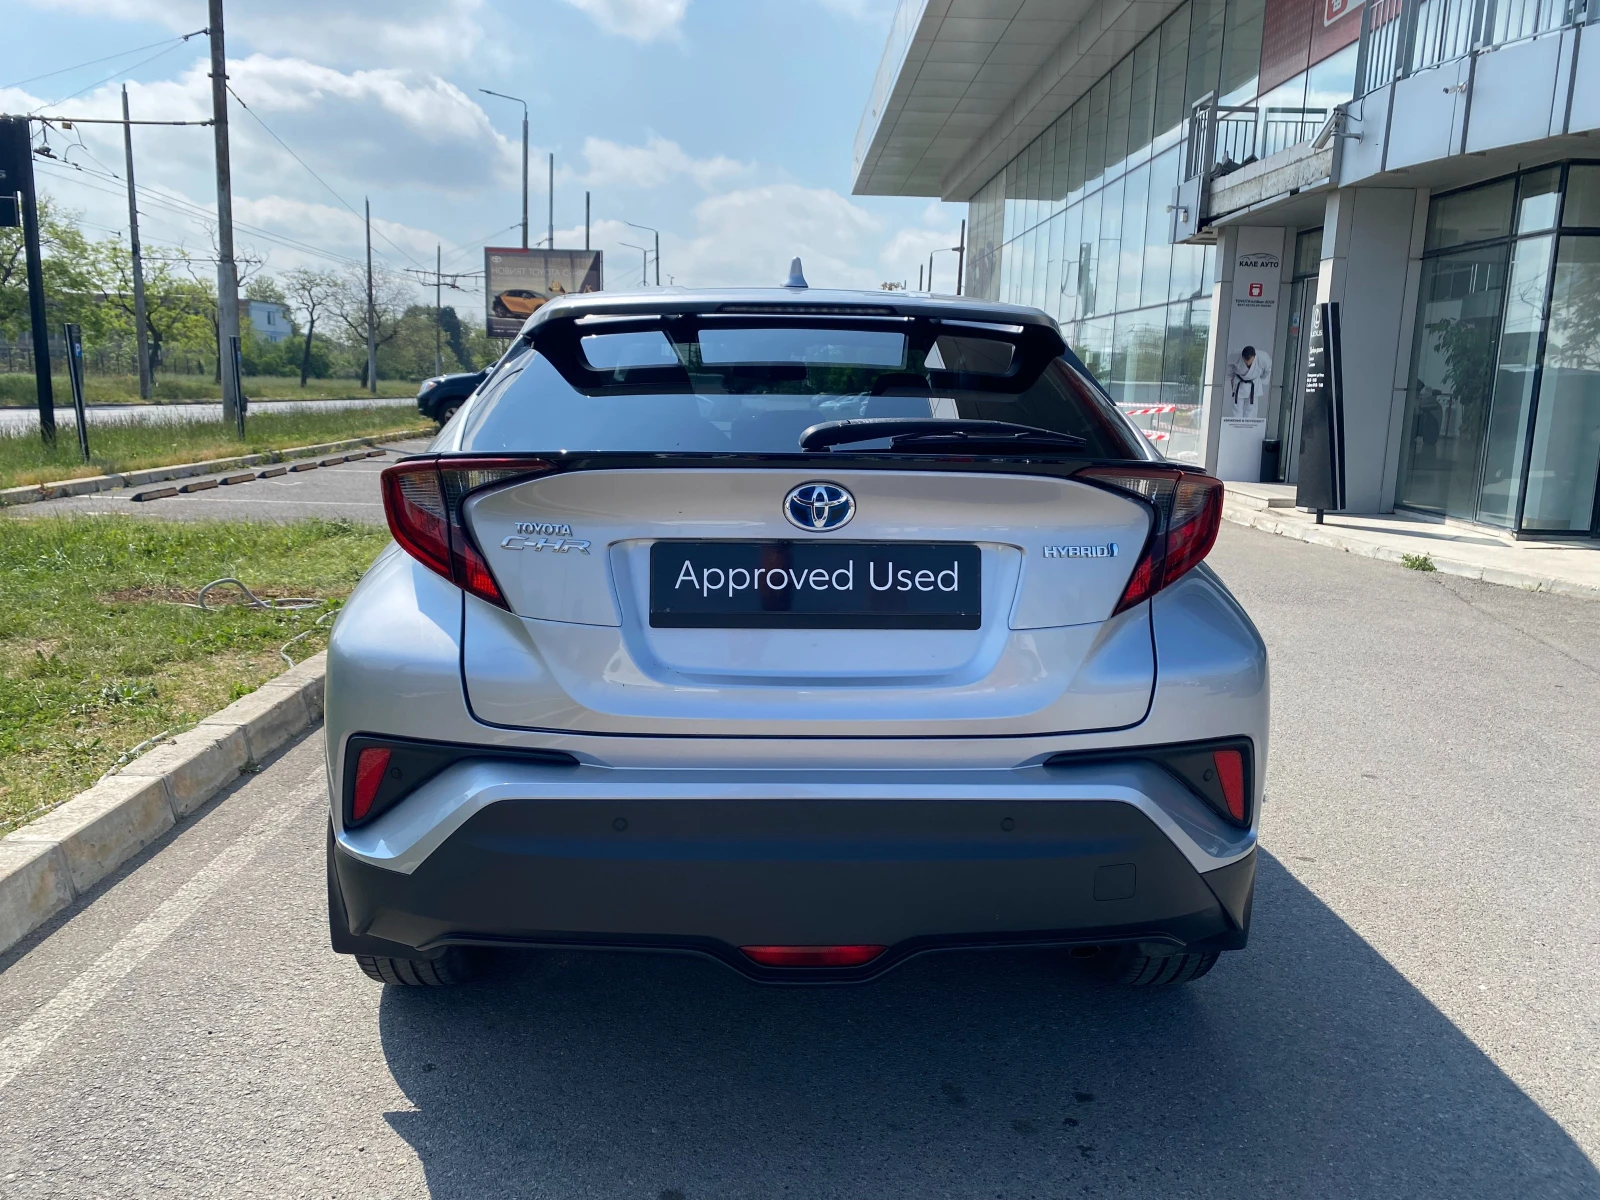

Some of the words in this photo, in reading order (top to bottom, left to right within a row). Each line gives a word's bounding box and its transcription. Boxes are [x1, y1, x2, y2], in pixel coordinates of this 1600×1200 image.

[492, 266, 526, 275] НОВИЯТ
[529, 267, 561, 276] TOYOTA
[514, 521, 573, 538] TOYOTA
[499, 536, 592, 555] C-HR
[1043, 545, 1110, 559] HYBRID
[674, 559, 854, 598] Approved
[869, 560, 959, 592] Used
